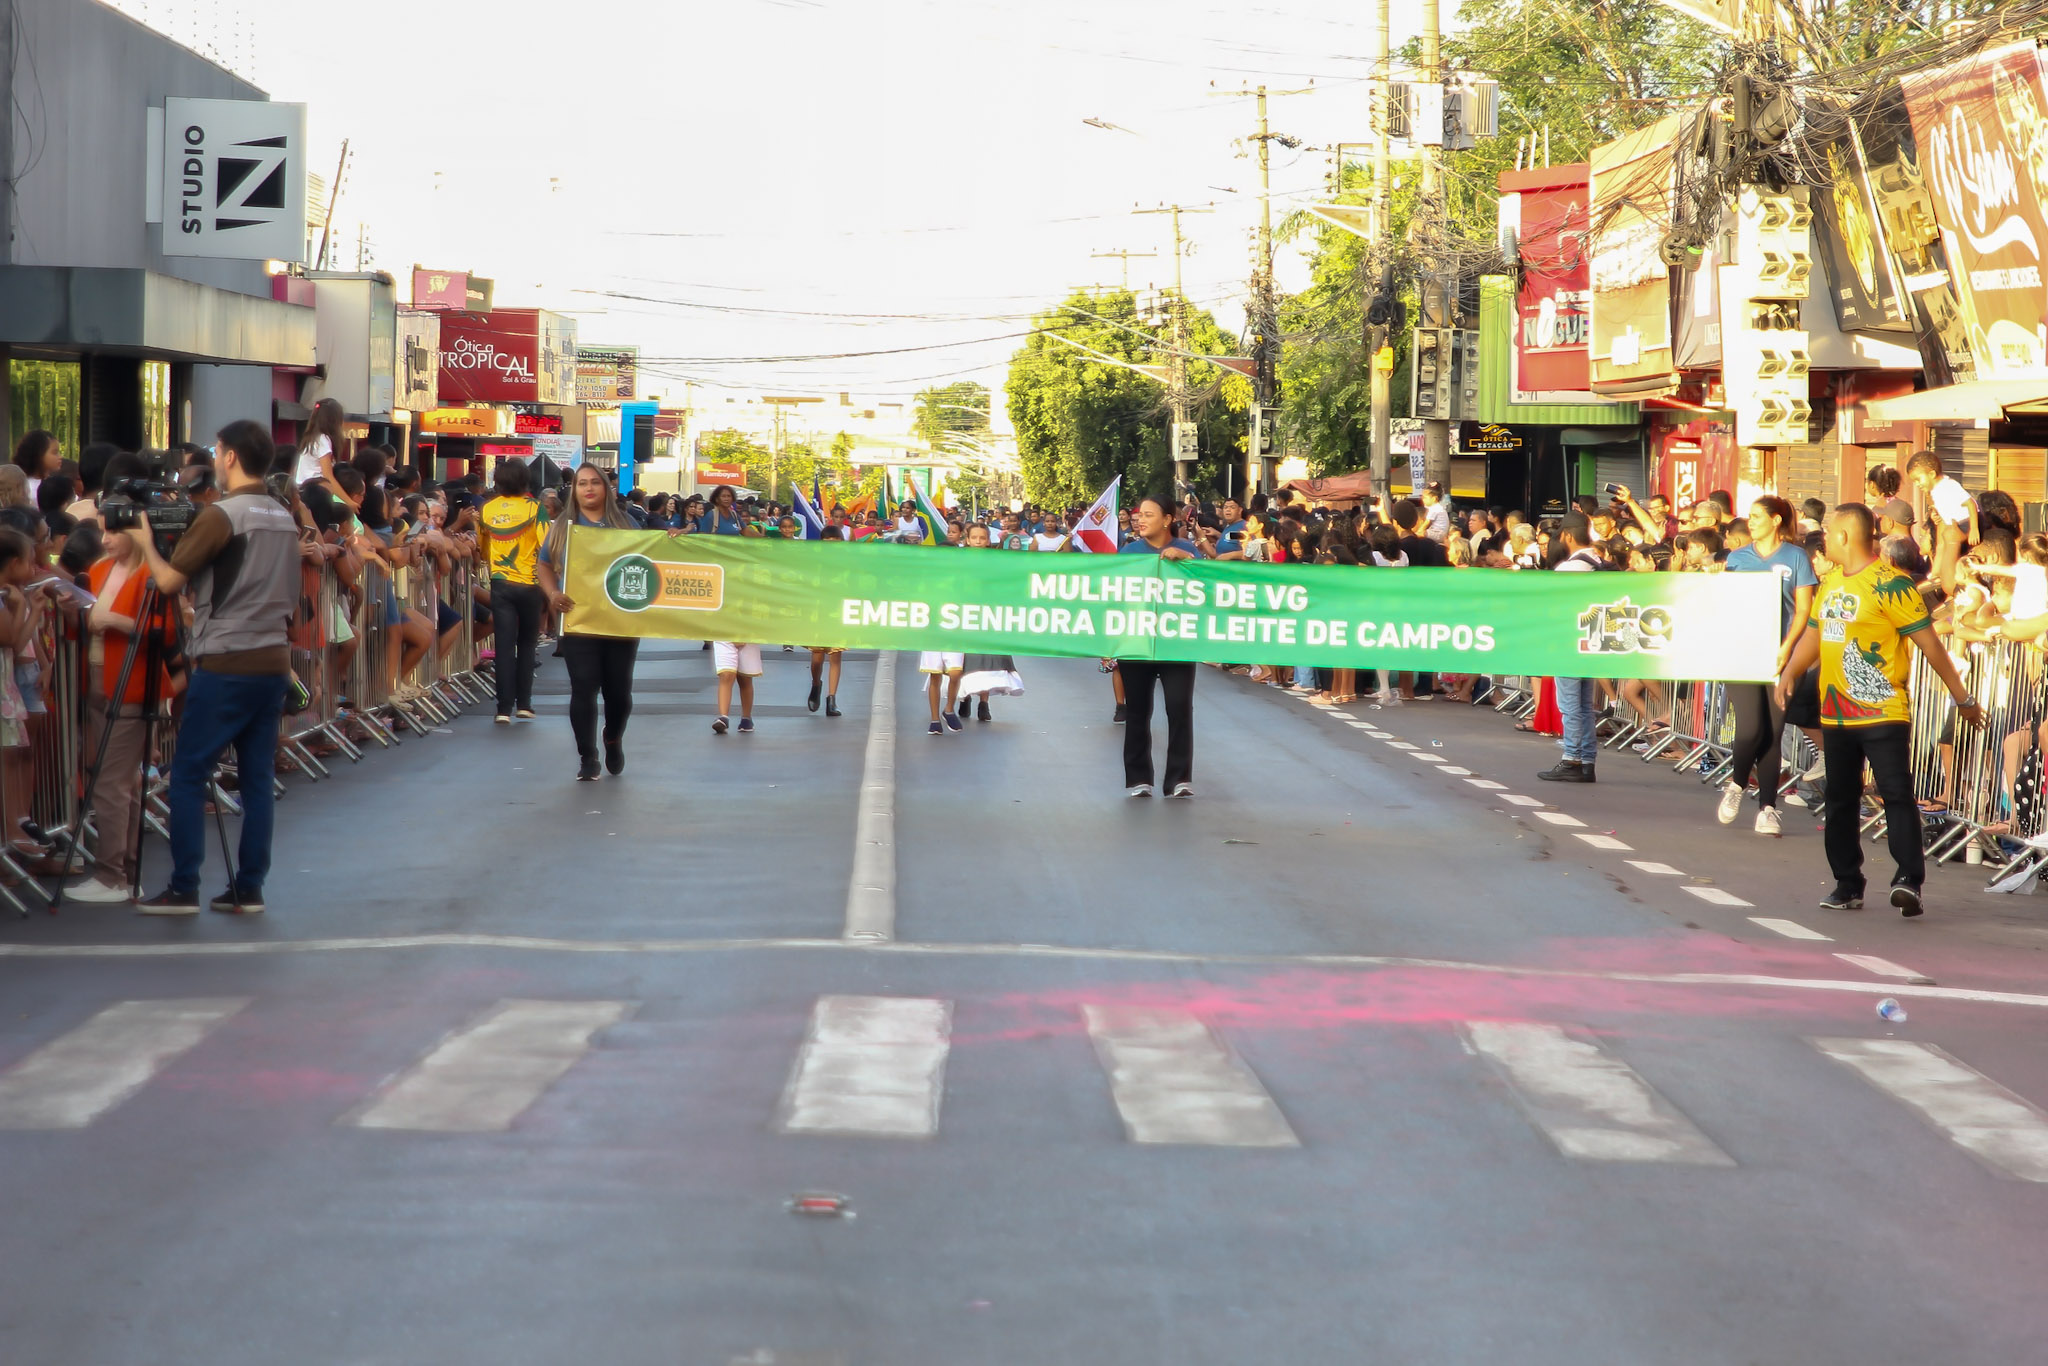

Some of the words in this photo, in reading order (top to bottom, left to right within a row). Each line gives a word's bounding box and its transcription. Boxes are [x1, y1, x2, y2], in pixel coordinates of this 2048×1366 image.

[182, 125, 205, 234] STUDIO
[454, 335, 494, 355] Ótica
[437, 352, 535, 377] TROPICAL
[520, 376, 537, 384] Grau
[432, 416, 485, 427] TUBE
[1477, 441, 1514, 449] ESTAÇÃO
[1483, 434, 1508, 442] ÓTICA
[665, 575, 713, 589] VÁRZEA
[665, 586, 713, 598] GRANDE
[1030, 572, 1205, 606] MULHERES
[1215, 582, 1257, 609] DE
[1264, 585, 1309, 611] VG
[842, 599, 930, 628] EMEB
[939, 602, 1096, 636] SENHORA
[1105, 609, 1198, 639] DIRCE
[1208, 614, 1297, 645] LEITE
[1306, 619, 1348, 646] DE
[1357, 621, 1496, 652] CAMPOS
